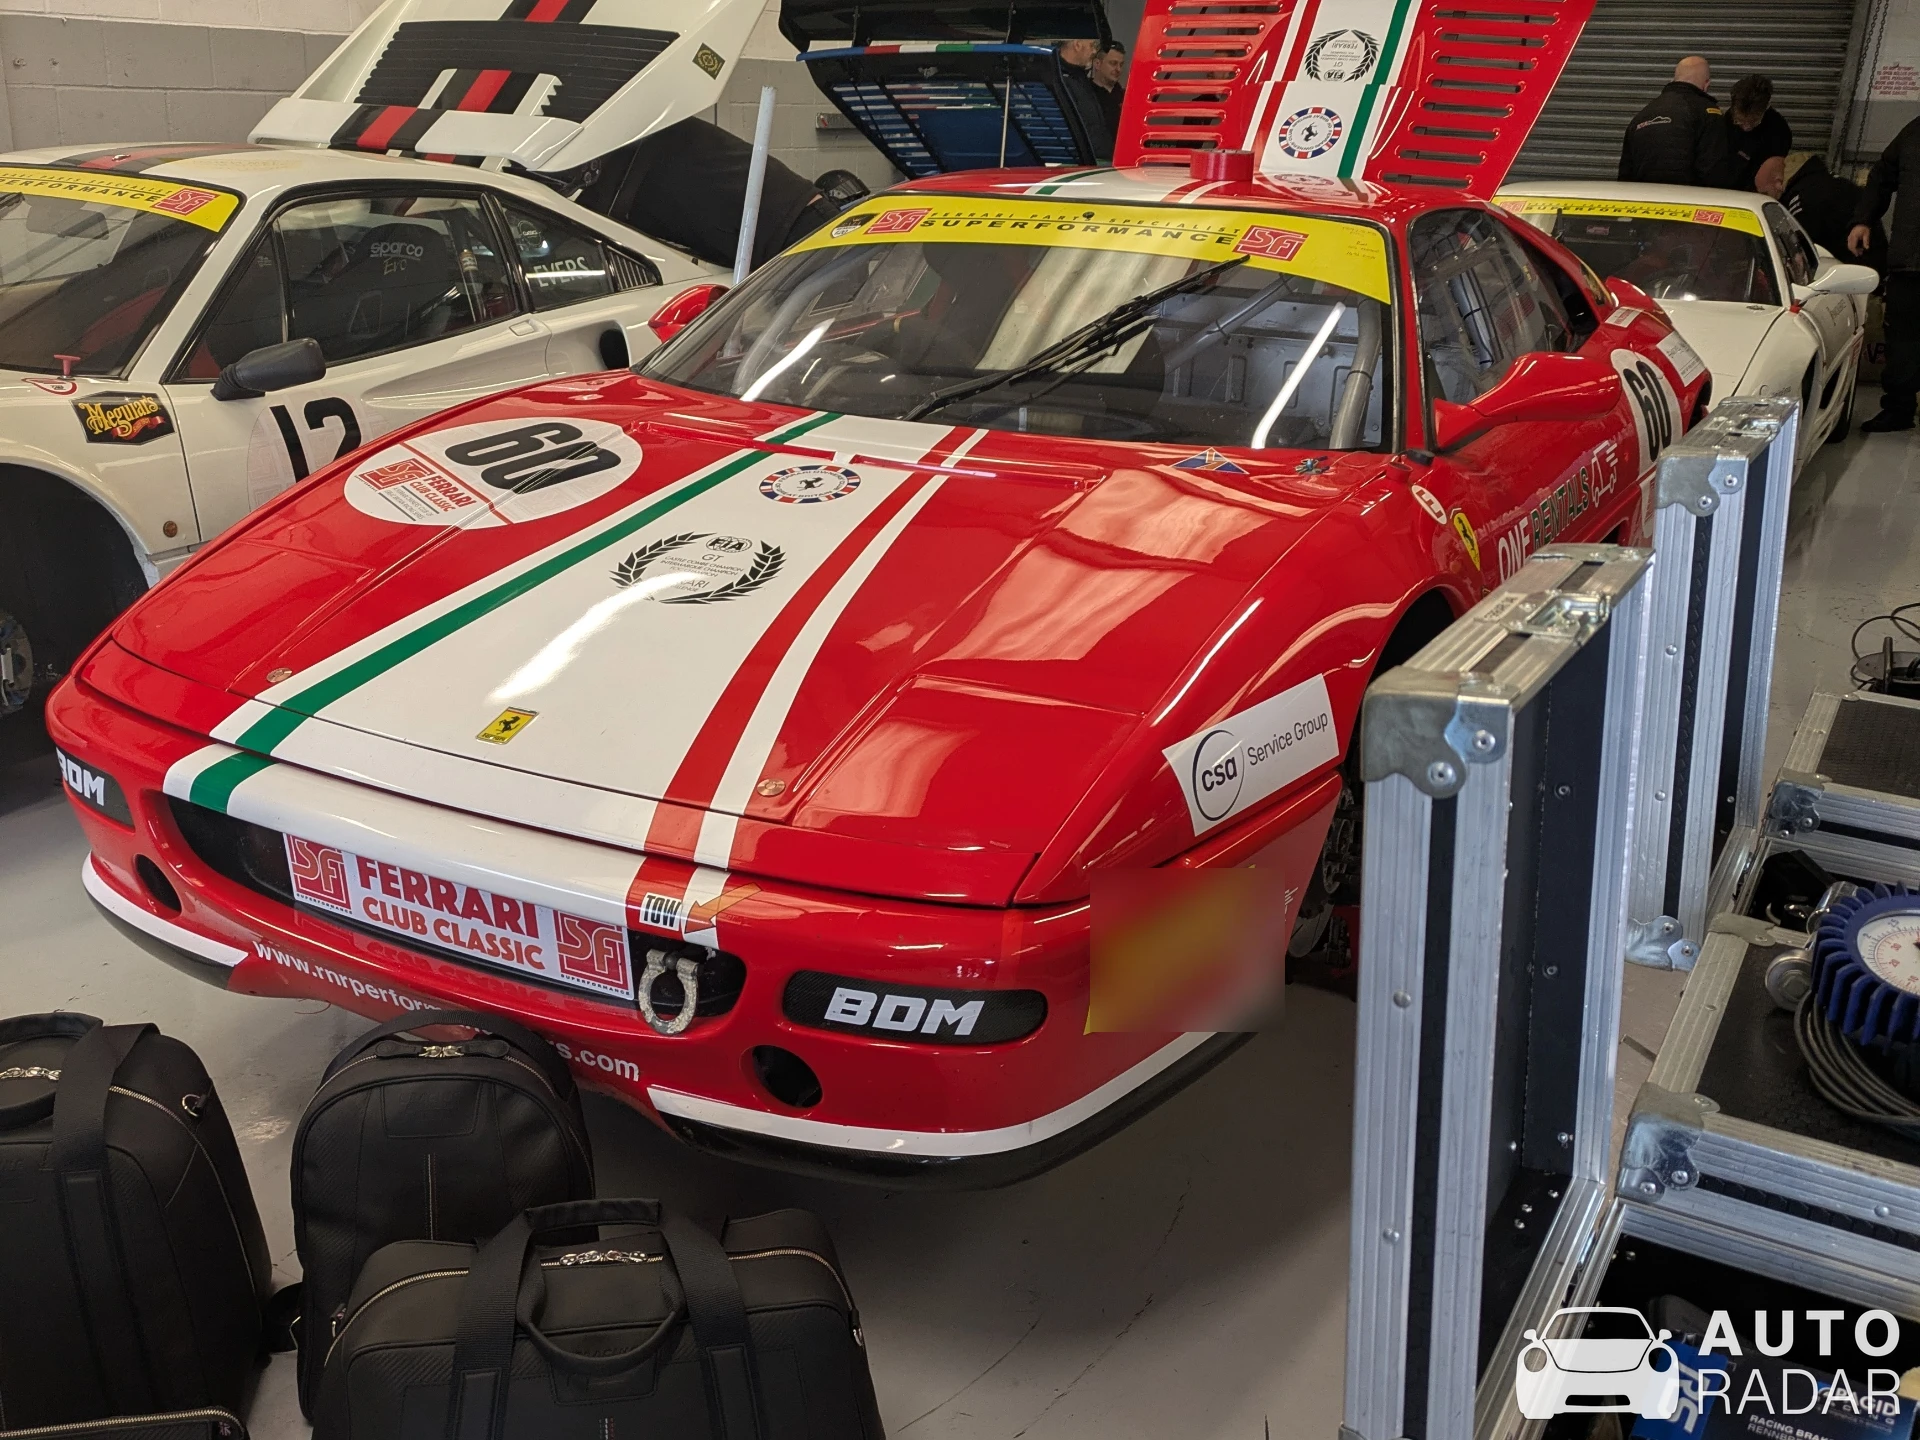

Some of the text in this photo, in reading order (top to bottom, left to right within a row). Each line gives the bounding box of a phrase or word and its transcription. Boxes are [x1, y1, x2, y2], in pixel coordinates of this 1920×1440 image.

[1327, 71, 1345, 80] FIA
[920, 219, 1235, 246] SUPERFORMANCE
[1031, 214, 1093, 222] PARTS
[1109, 218, 1241, 234] SPECIALIST
[371, 242, 424, 258] sparco
[533, 256, 589, 288] EVERS
[1623, 361, 1672, 462] 60
[269, 397, 361, 483] 12
[445, 422, 622, 494] 60
[410, 481, 432, 494] CLUB
[425, 492, 457, 512] CLASSIC
[424, 475, 477, 507] FERRARI
[1498, 517, 1531, 583] ONE
[1530, 466, 1589, 548] RENTALS
[702, 554, 724, 562] GT
[708, 538, 745, 550] FIA
[703, 567, 738, 576] CHAMPION
[709, 563, 744, 572] CHAMPION
[1202, 712, 1329, 792] csa Service Group
[296, 893, 353, 914] SUPERFORMANCE
[356, 854, 540, 940] FERRARI
[643, 895, 681, 928] TOW
[362, 896, 547, 971] CLUB CLASSIC
[560, 973, 631, 996] SUPERFORMANCE
[1750, 1414, 1794, 1434] RACING
